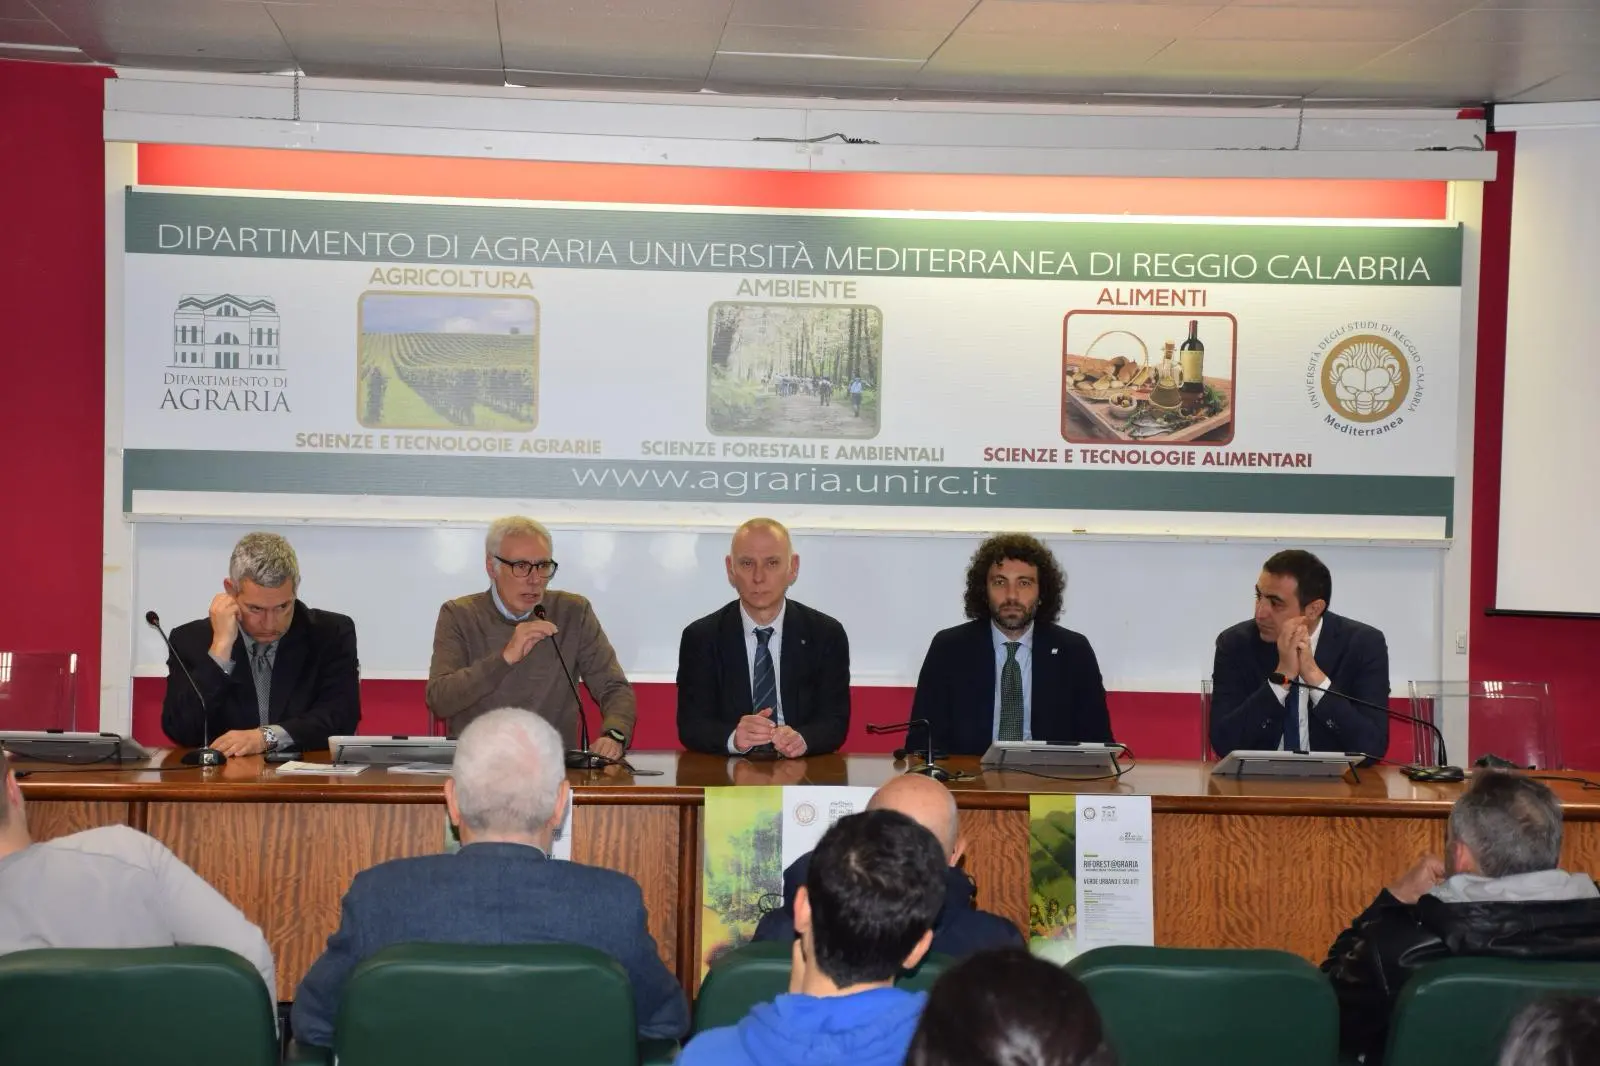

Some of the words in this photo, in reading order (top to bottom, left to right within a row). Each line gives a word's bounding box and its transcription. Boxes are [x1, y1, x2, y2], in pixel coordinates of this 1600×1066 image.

[158, 223, 415, 258] DIPARTIMENTO
[426, 236, 458, 259] DI
[471, 237, 617, 263] AGRARIA
[629, 241, 814, 269] UNIVERSITÀ
[825, 246, 1078, 278] MEDITERRANEA
[1090, 253, 1121, 276] DI
[1133, 253, 1257, 278] REGGIO
[1267, 255, 1430, 281] CALABRIA
[369, 267, 534, 289] AGRICOLTURA
[736, 278, 856, 299] AMBIENTE
[1097, 288, 1207, 307] ALIMENTI
[1307, 352, 1320, 408] UNIVERSITÀ
[1318, 328, 1345, 349] DEGLI
[1348, 321, 1378, 330] STUDI
[1381, 324, 1391, 333] DI
[1393, 330, 1420, 362] REGGIO
[1408, 366, 1424, 412] CALABRIA
[159, 388, 291, 412] AGRARIA
[1324, 414, 1403, 436] Mediterranea
[296, 432, 373, 449] SCIENZE
[380, 436, 389, 449] E
[392, 435, 512, 452] TECNOLOGIE
[519, 438, 601, 454] AGRARIE
[641, 440, 715, 456] SCIENZE
[723, 442, 815, 458] FORESTALI
[821, 445, 828, 459] E
[835, 445, 944, 462] AMBIENTALI
[984, 447, 1057, 463] SCIENZE
[1065, 449, 1073, 463] E
[1080, 449, 1195, 466] TECNOLOGIE
[1202, 451, 1312, 468] ALIMENTARI
[572, 467, 997, 496] www.agraria.unirc.it
